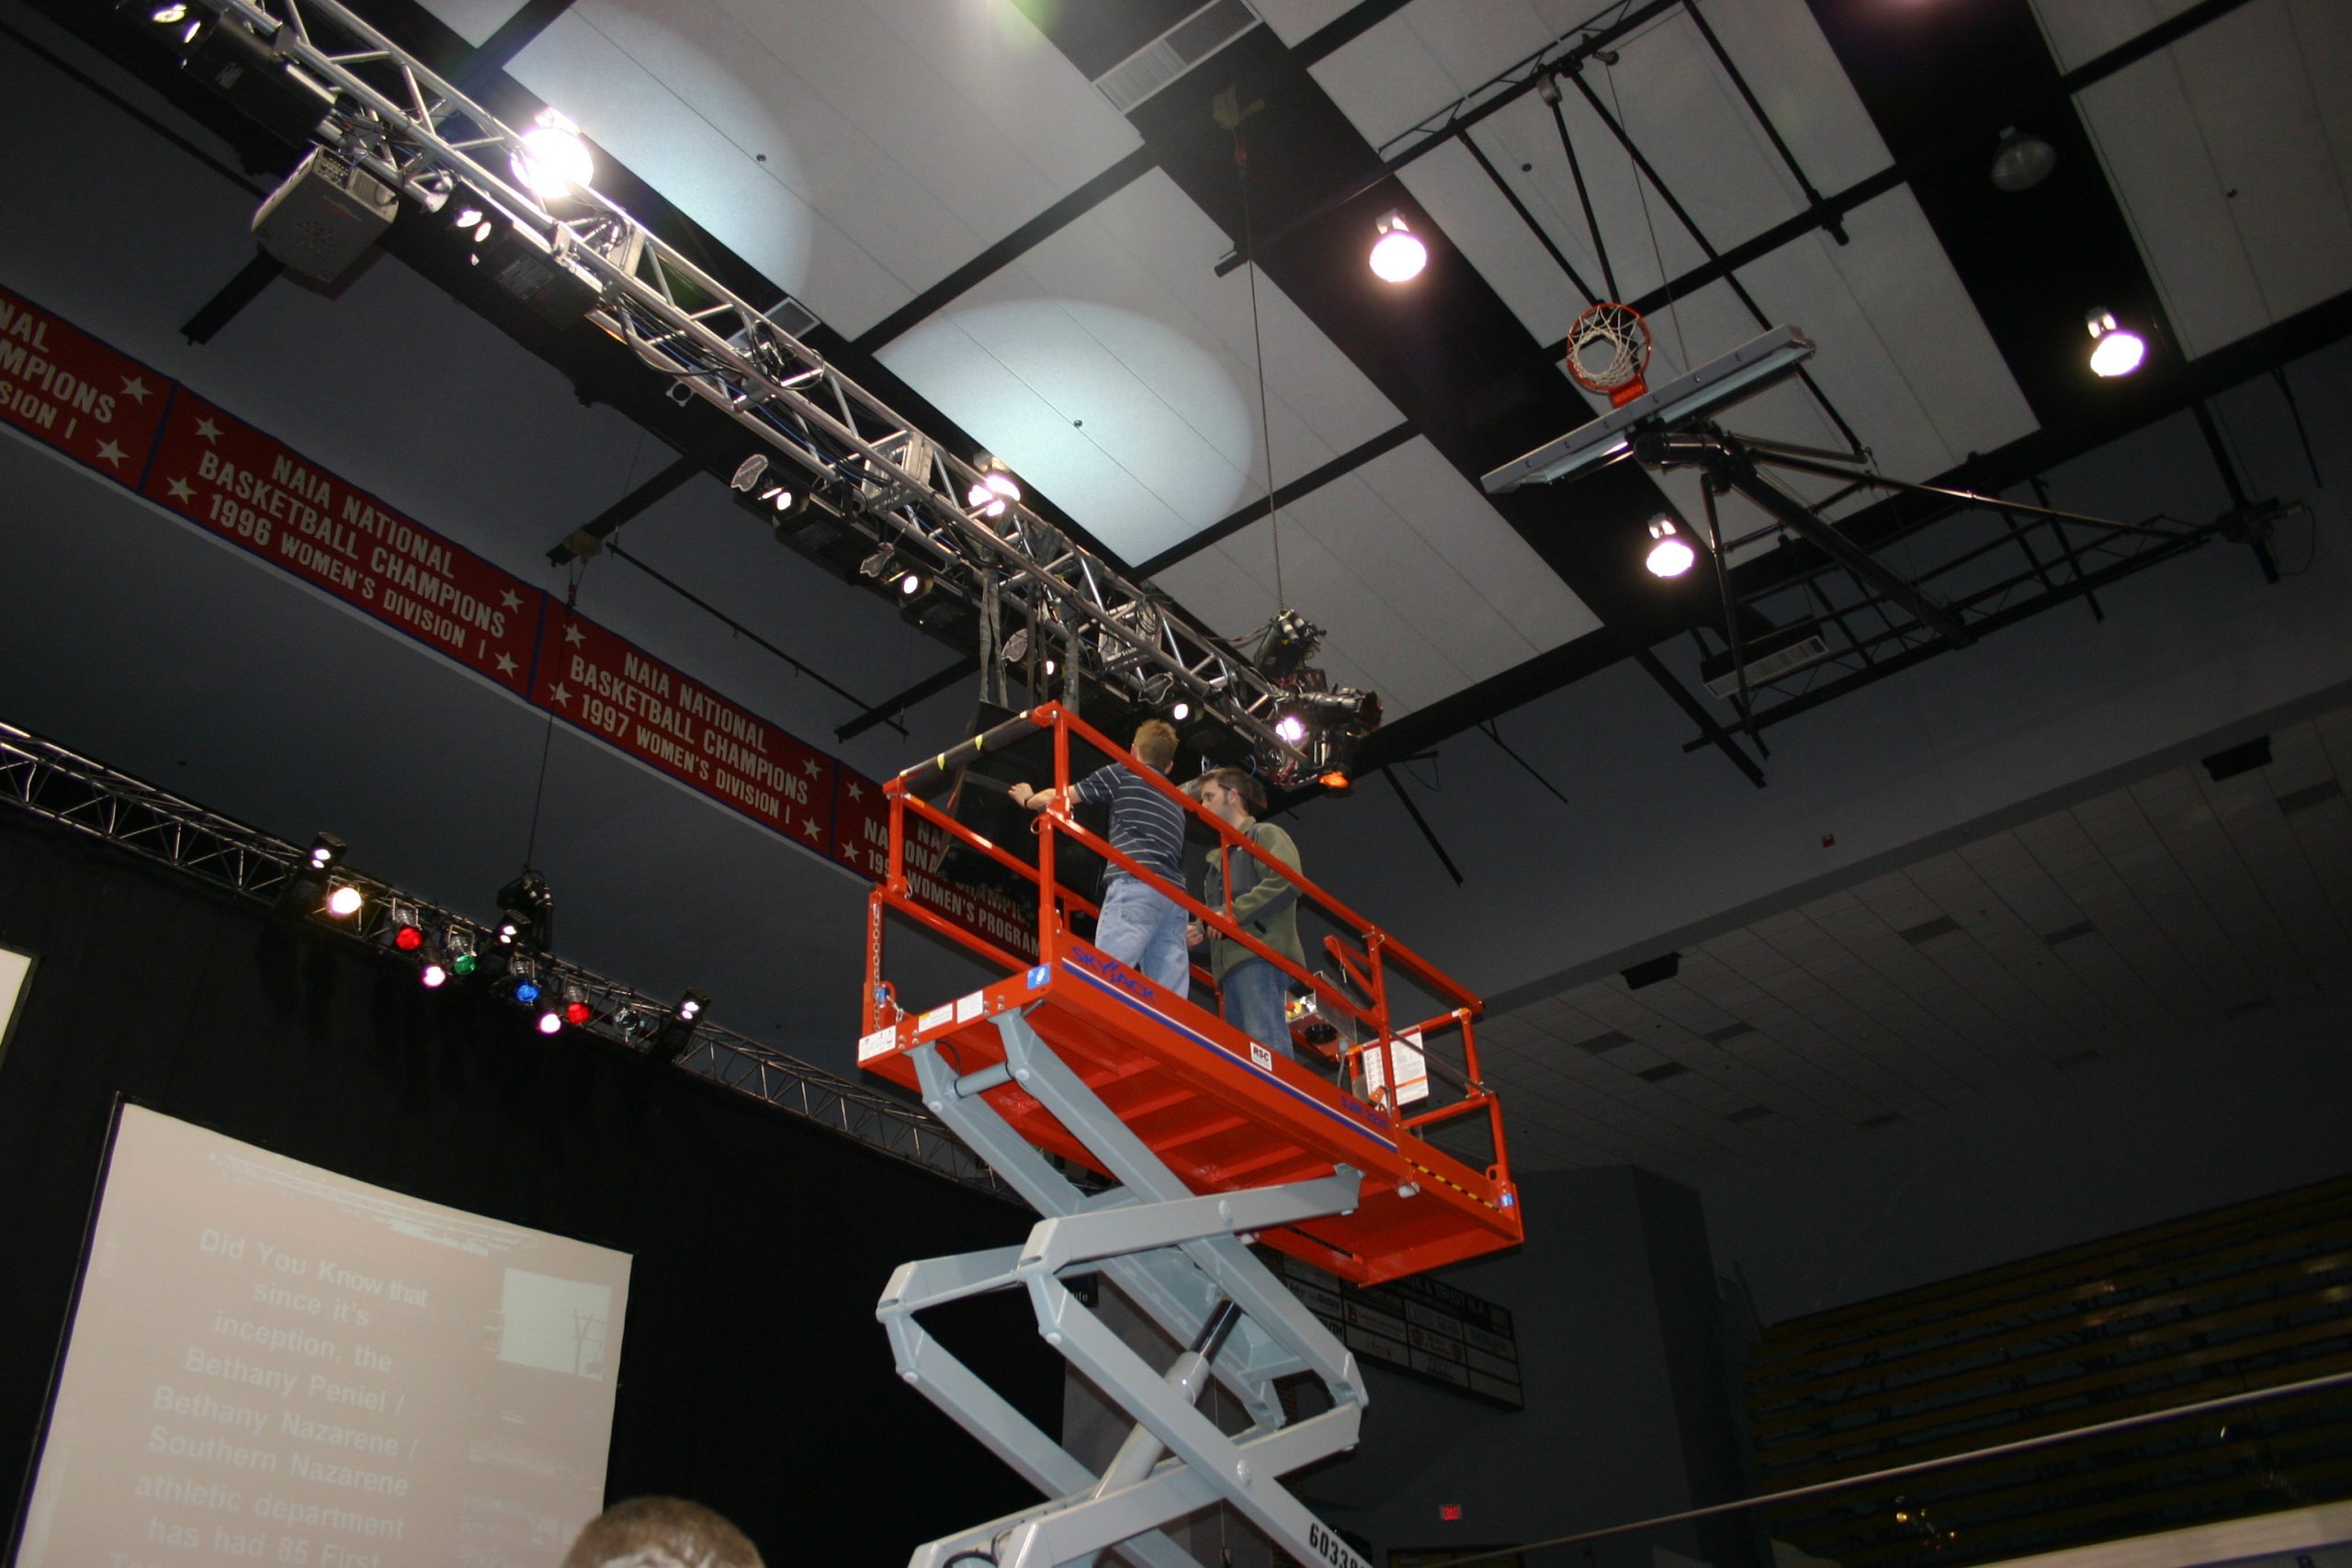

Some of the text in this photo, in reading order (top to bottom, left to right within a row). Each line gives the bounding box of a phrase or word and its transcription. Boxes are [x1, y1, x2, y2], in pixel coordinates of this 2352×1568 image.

[64, 417, 77, 440] I
[198, 450, 506, 638] BASKETBALL CHAMPIONS
[272, 454, 455, 580] NAIA NATIONAL
[209, 493, 486, 660] 1996 WOMEN'S DIVISION I
[570, 654, 808, 806] BASKETBALL CHAMPIONS
[624, 651, 768, 754] NAIA NATIONAL
[581, 694, 790, 825] 1997 WOMEN'S DIVISION I
[907, 868, 975, 922] WOMEN'S
[199, 1226, 429, 1309] Did You Know that
[254, 1282, 369, 1327] since it's
[185, 1346, 299, 1398] Bethany
[308, 1373, 387, 1413] Peniel
[354, 1344, 393, 1373] the
[152, 1383, 269, 1436] Bethany
[280, 1409, 400, 1457] Nazarene
[147, 1424, 410, 1499] Southern Nazarene
[135, 1473, 405, 1541] athletic department
[147, 1516, 200, 1549] has
[213, 1525, 266, 1559] had
[321, 1542, 381, 1568] First
